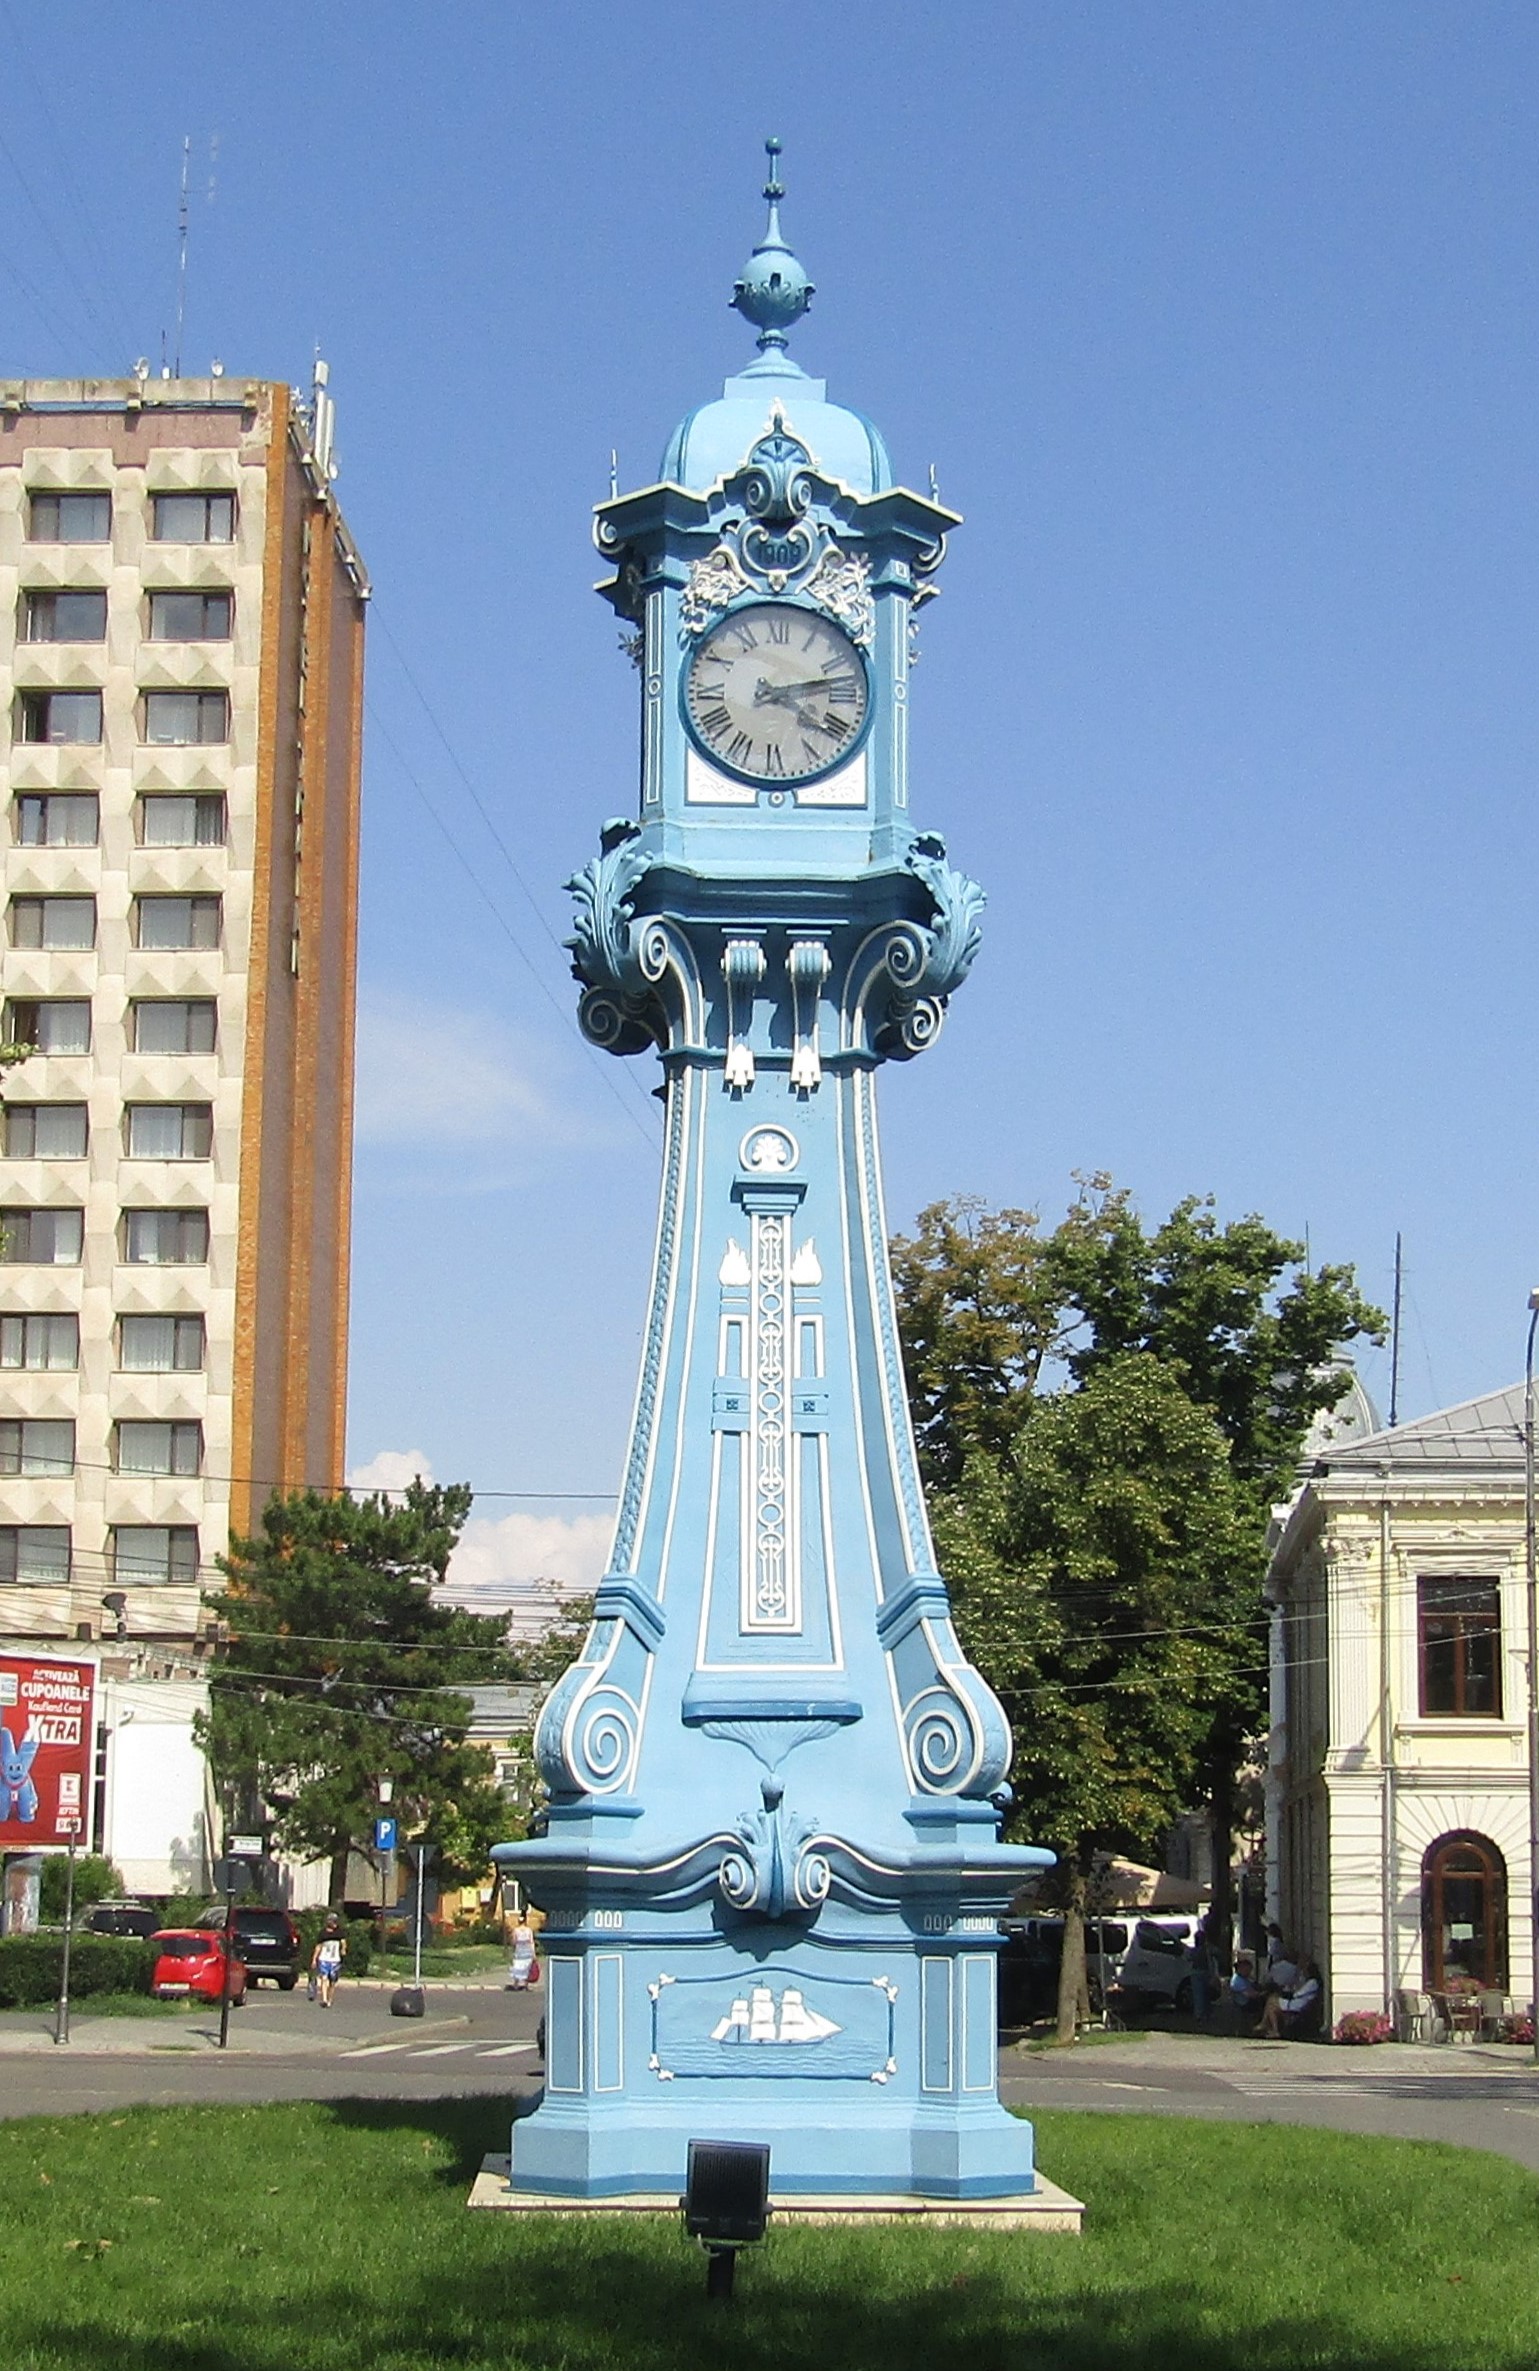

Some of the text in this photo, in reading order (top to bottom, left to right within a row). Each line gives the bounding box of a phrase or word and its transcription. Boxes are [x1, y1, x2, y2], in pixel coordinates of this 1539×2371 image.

[766, 620, 790, 645] XII
[21, 1682, 90, 1701] CUPOANELE
[28, 1700, 62, 1713] Kaufland
[23, 1714, 78, 1743] XTRA
[381, 1821, 392, 1840] P
